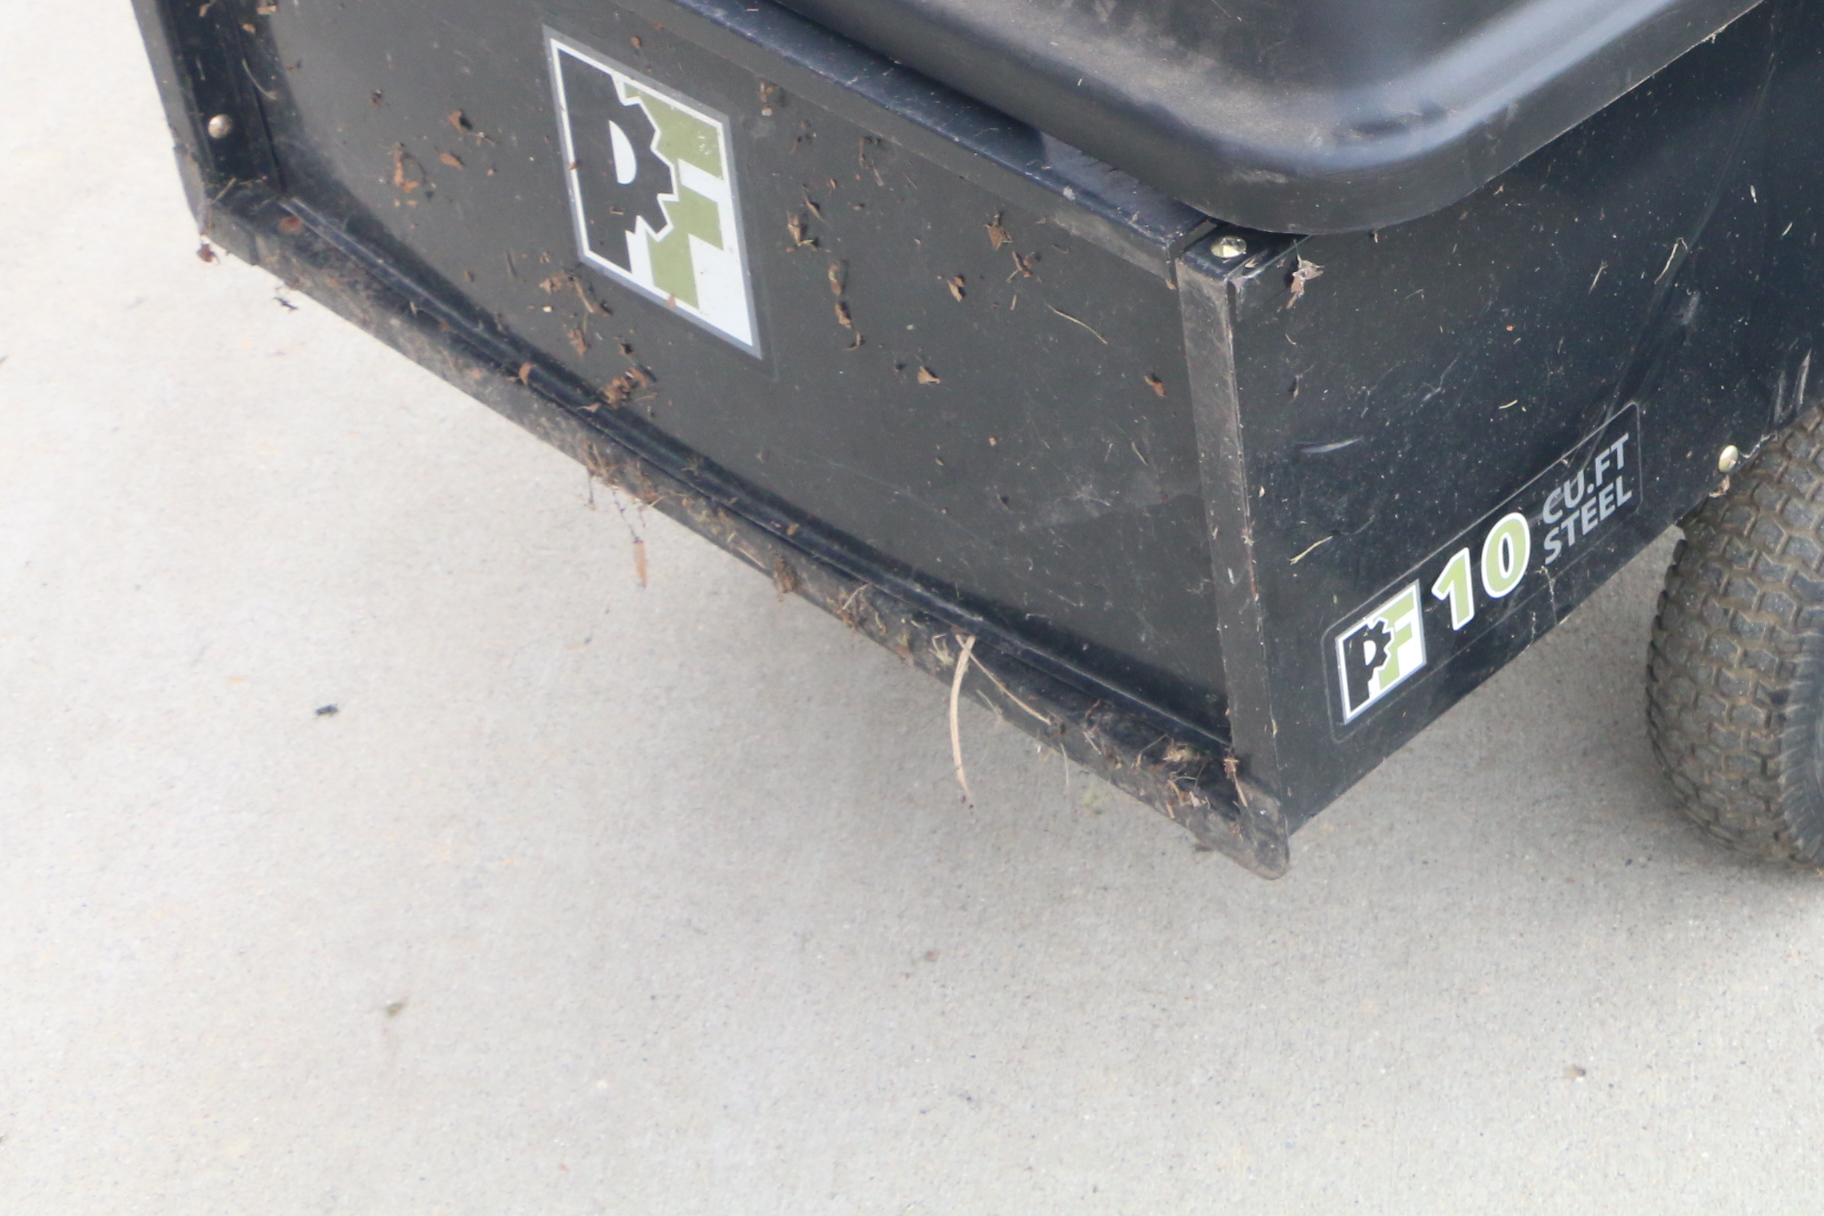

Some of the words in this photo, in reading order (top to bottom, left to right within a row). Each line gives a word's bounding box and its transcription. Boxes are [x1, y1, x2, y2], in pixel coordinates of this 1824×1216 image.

[1541, 432, 1630, 526] CU.FT
[1543, 474, 1633, 566] STEEL
[1431, 512, 1532, 632] 10
